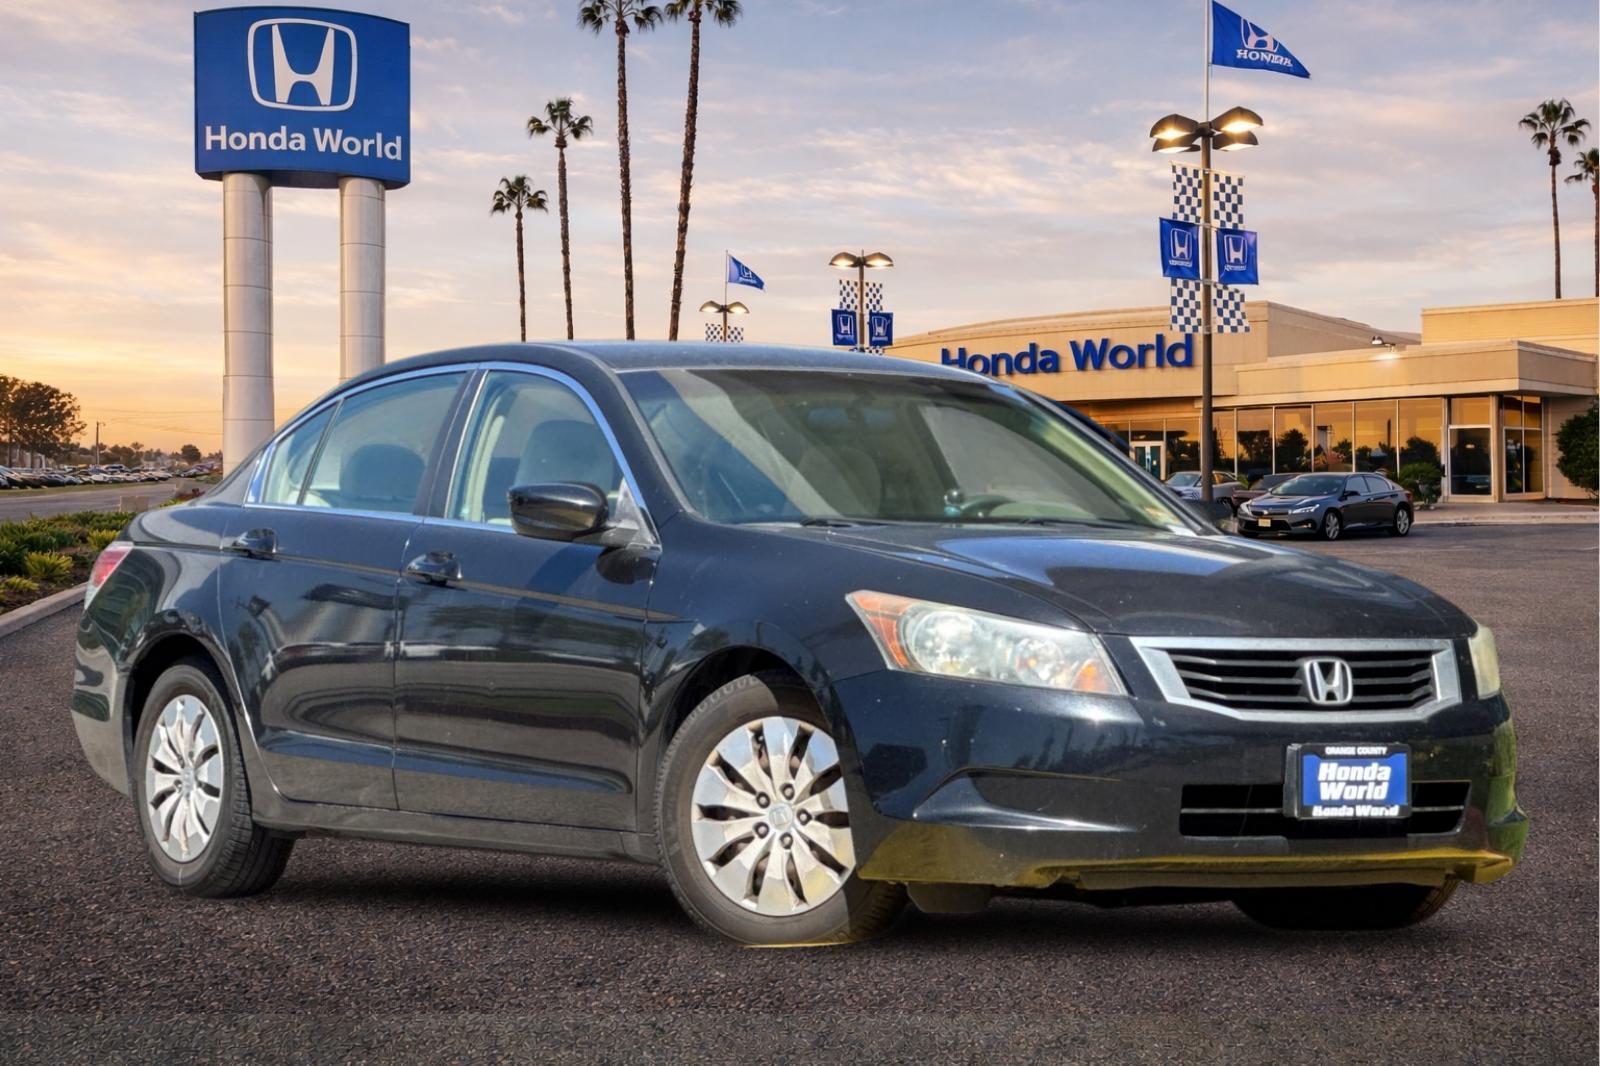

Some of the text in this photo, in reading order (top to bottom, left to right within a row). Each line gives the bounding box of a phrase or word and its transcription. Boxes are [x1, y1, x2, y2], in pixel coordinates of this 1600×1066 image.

[205, 125, 402, 161] Honda World
[941, 333, 1194, 377] Honda World
[1318, 762, 1392, 781] Honda
[1319, 781, 1389, 800] World
